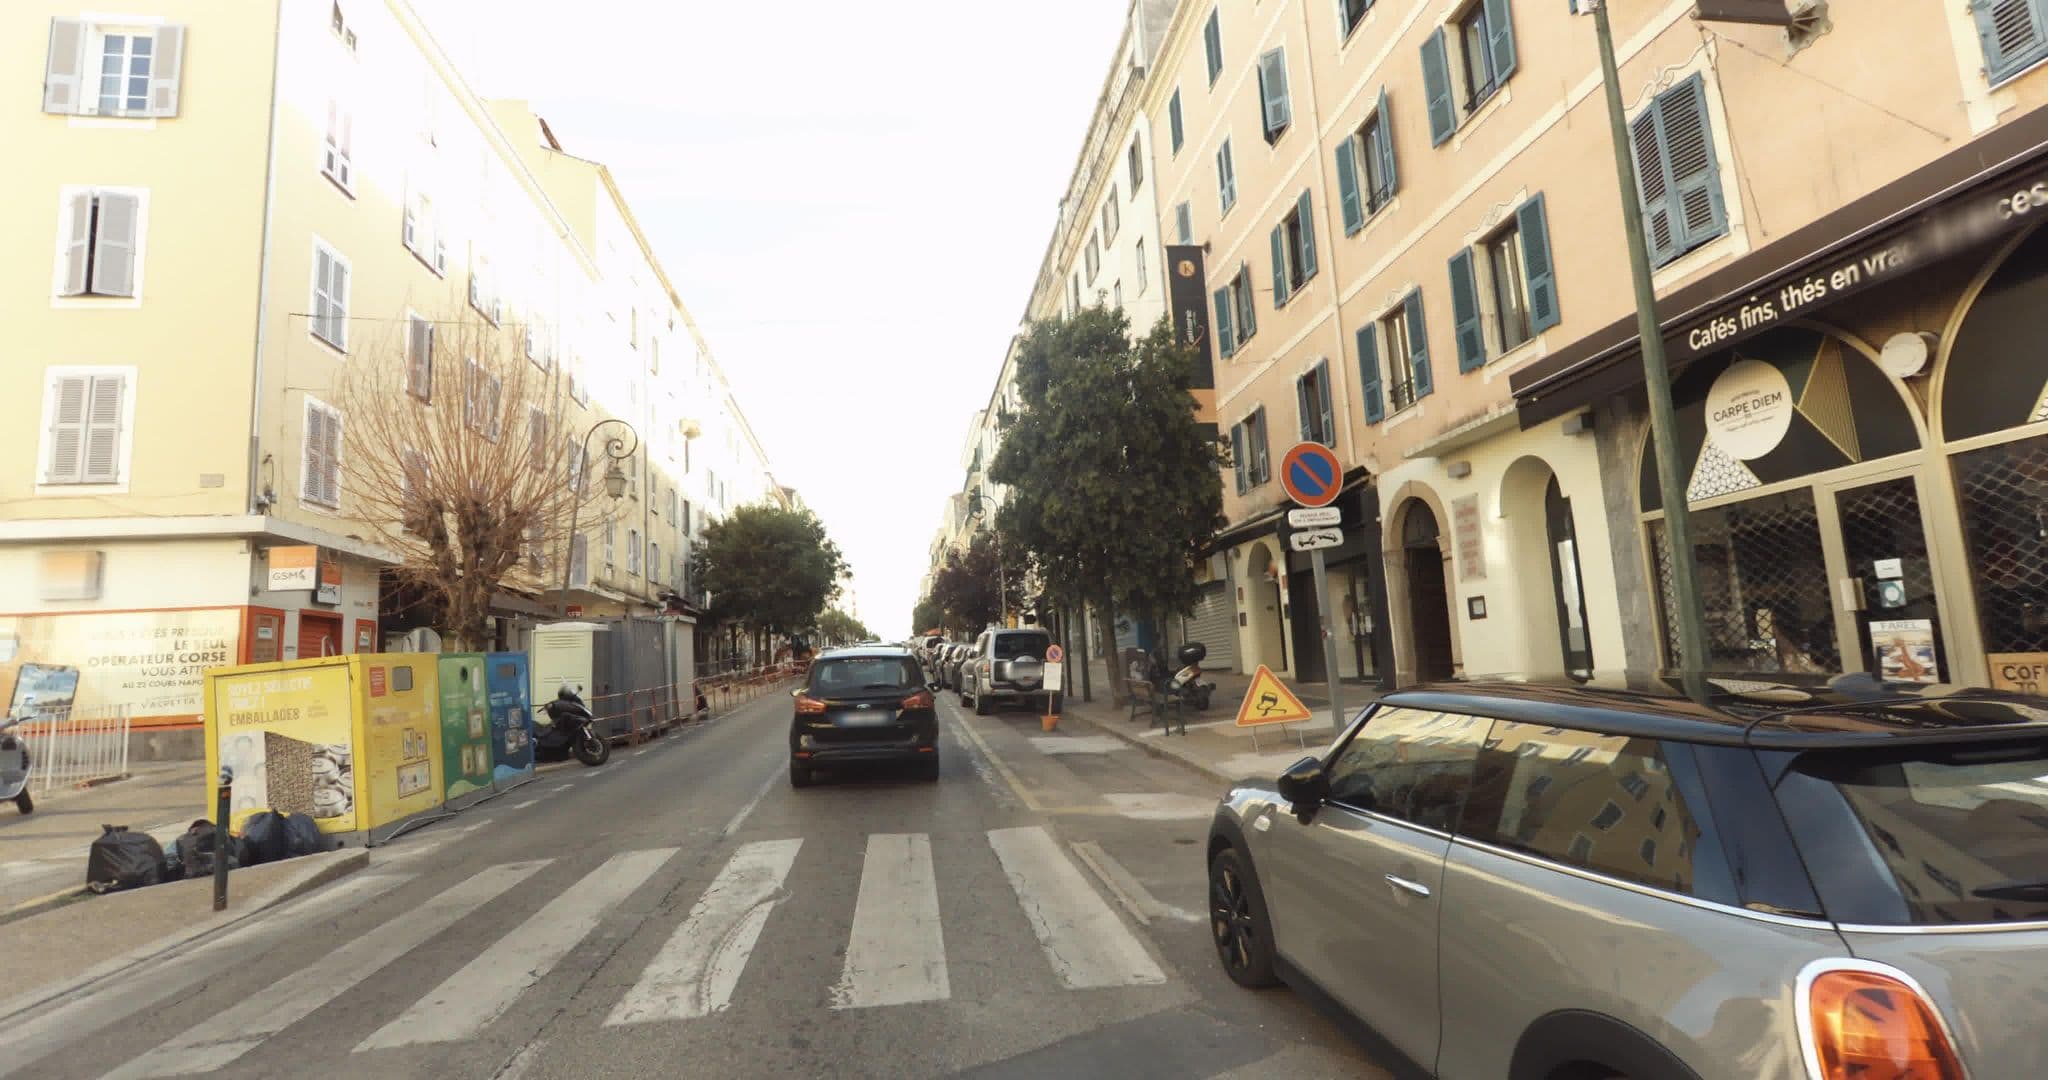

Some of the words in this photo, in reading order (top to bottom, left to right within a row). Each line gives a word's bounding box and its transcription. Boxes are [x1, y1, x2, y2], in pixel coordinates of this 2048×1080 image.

[1689, 317, 1738, 350] Cafés
[1740, 296, 1779, 331] fins,
[1780, 277, 1827, 312] thés
[1830, 263, 1860, 290] en
[1713, 401, 1750, 422] CARPE
[1752, 391, 1783, 410] DIEM
[178, 651, 226, 663] CORSE
[141, 666, 176, 677] VOUS
[2002, 664, 2048, 681] COF
[229, 708, 300, 725] EMBALLAGES
